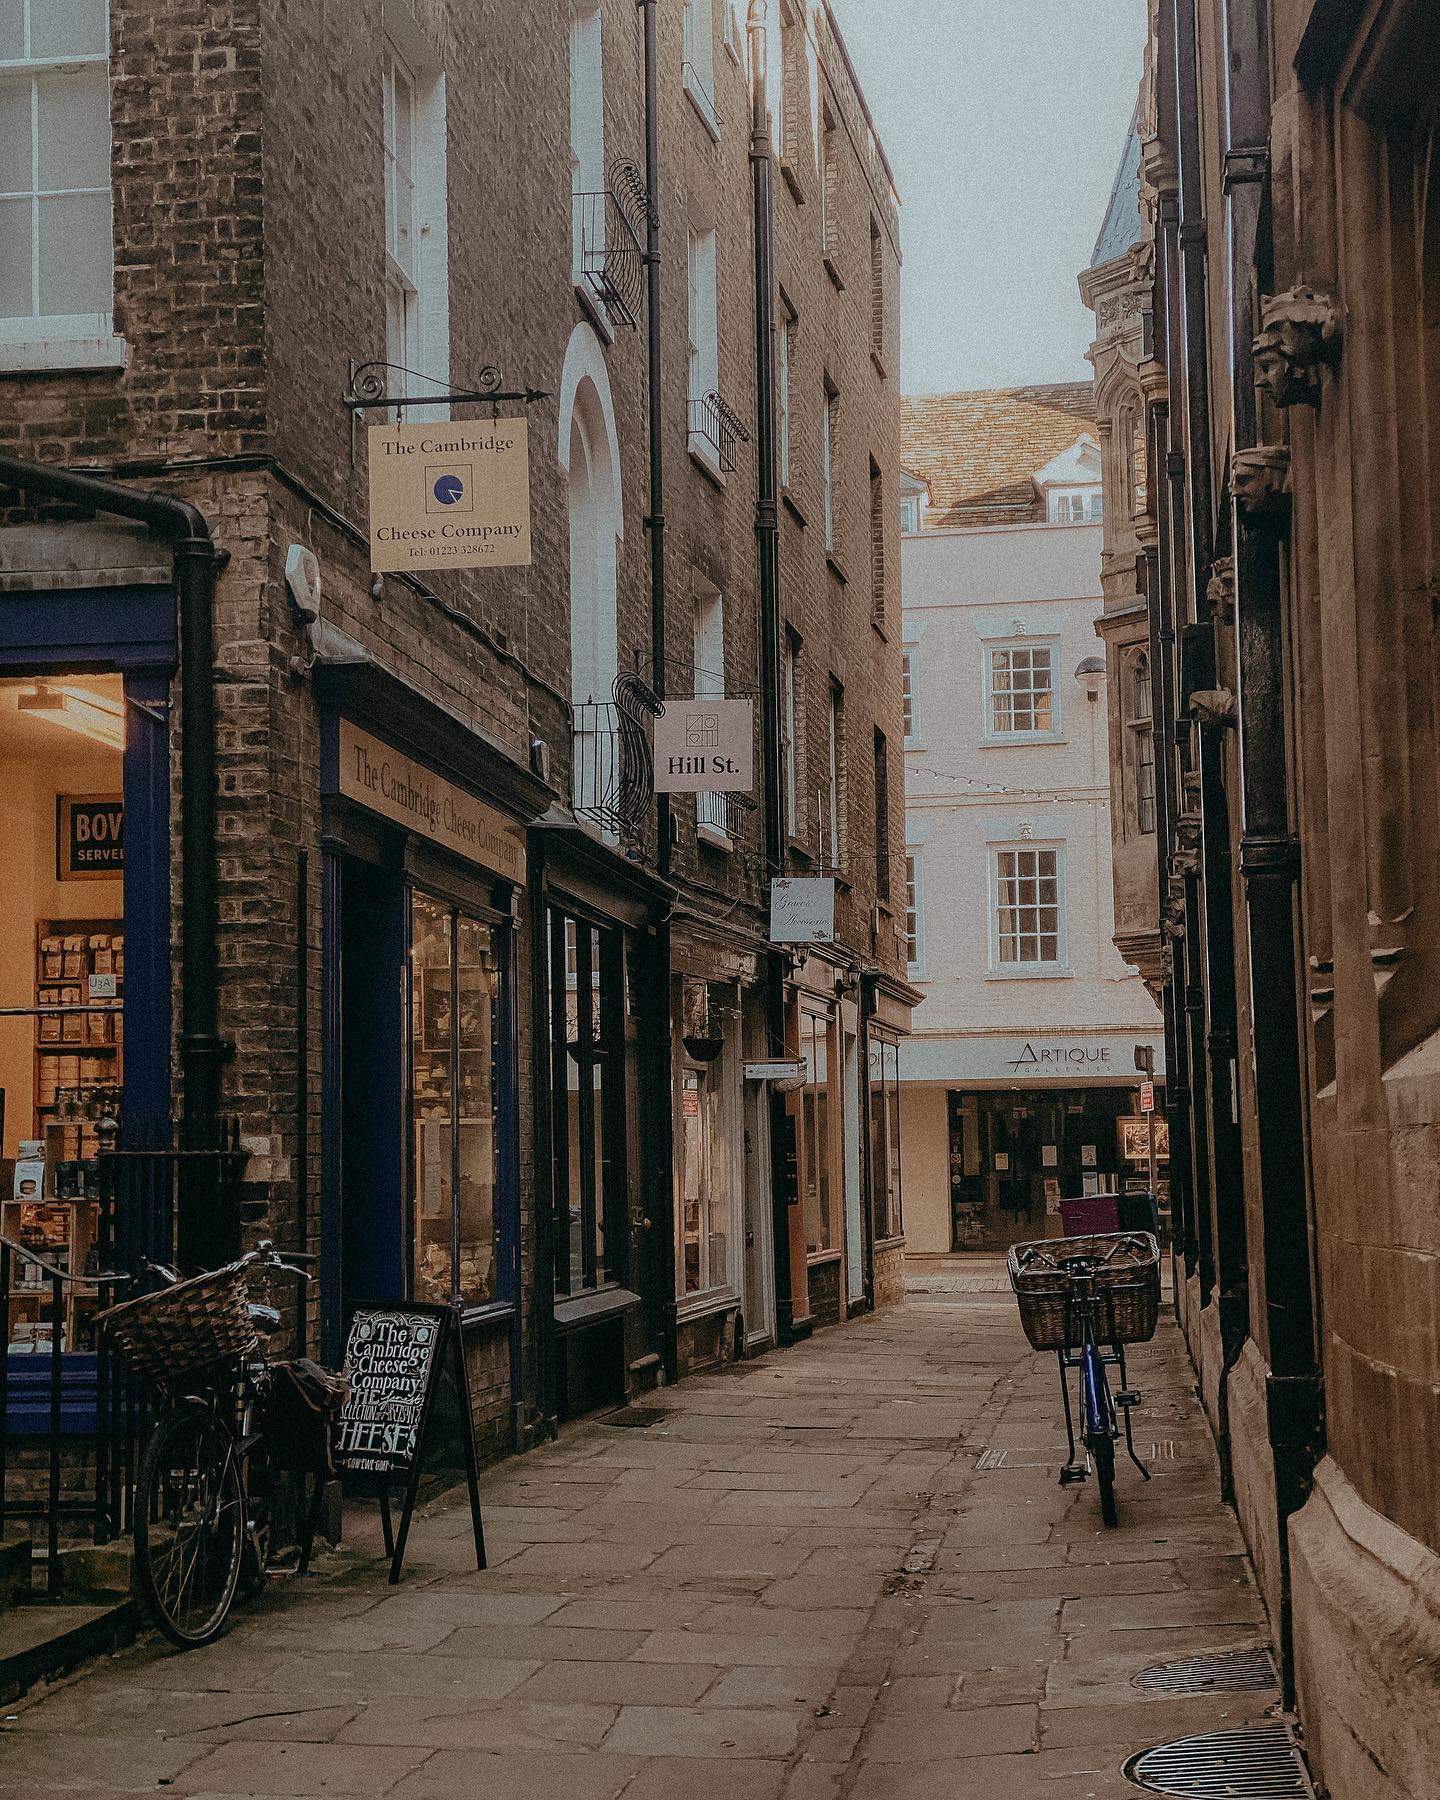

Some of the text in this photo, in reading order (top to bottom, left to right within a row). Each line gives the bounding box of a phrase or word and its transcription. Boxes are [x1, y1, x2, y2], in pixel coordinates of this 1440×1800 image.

[381, 436, 514, 455] The Cambridge
[376, 524, 523, 541] Cheese Company
[408, 544, 495, 557] Tel: 01223 328672
[668, 755, 740, 774] Hill St.
[353, 744, 518, 874] The Cambridge Cheese Company
[76, 813, 124, 842] BOV
[1005, 1042, 1111, 1073] ARTIQUE
[1024, 1065, 1112, 1073] GALLERIES
[376, 1322, 407, 1343] The
[353, 1339, 430, 1367] Cambridge
[358, 1356, 408, 1375] Cheese
[351, 1371, 422, 1397] Company
[350, 1387, 380, 1405] THE
[340, 1404, 377, 1421] SELECTION
[335, 1421, 418, 1456] HEESES
